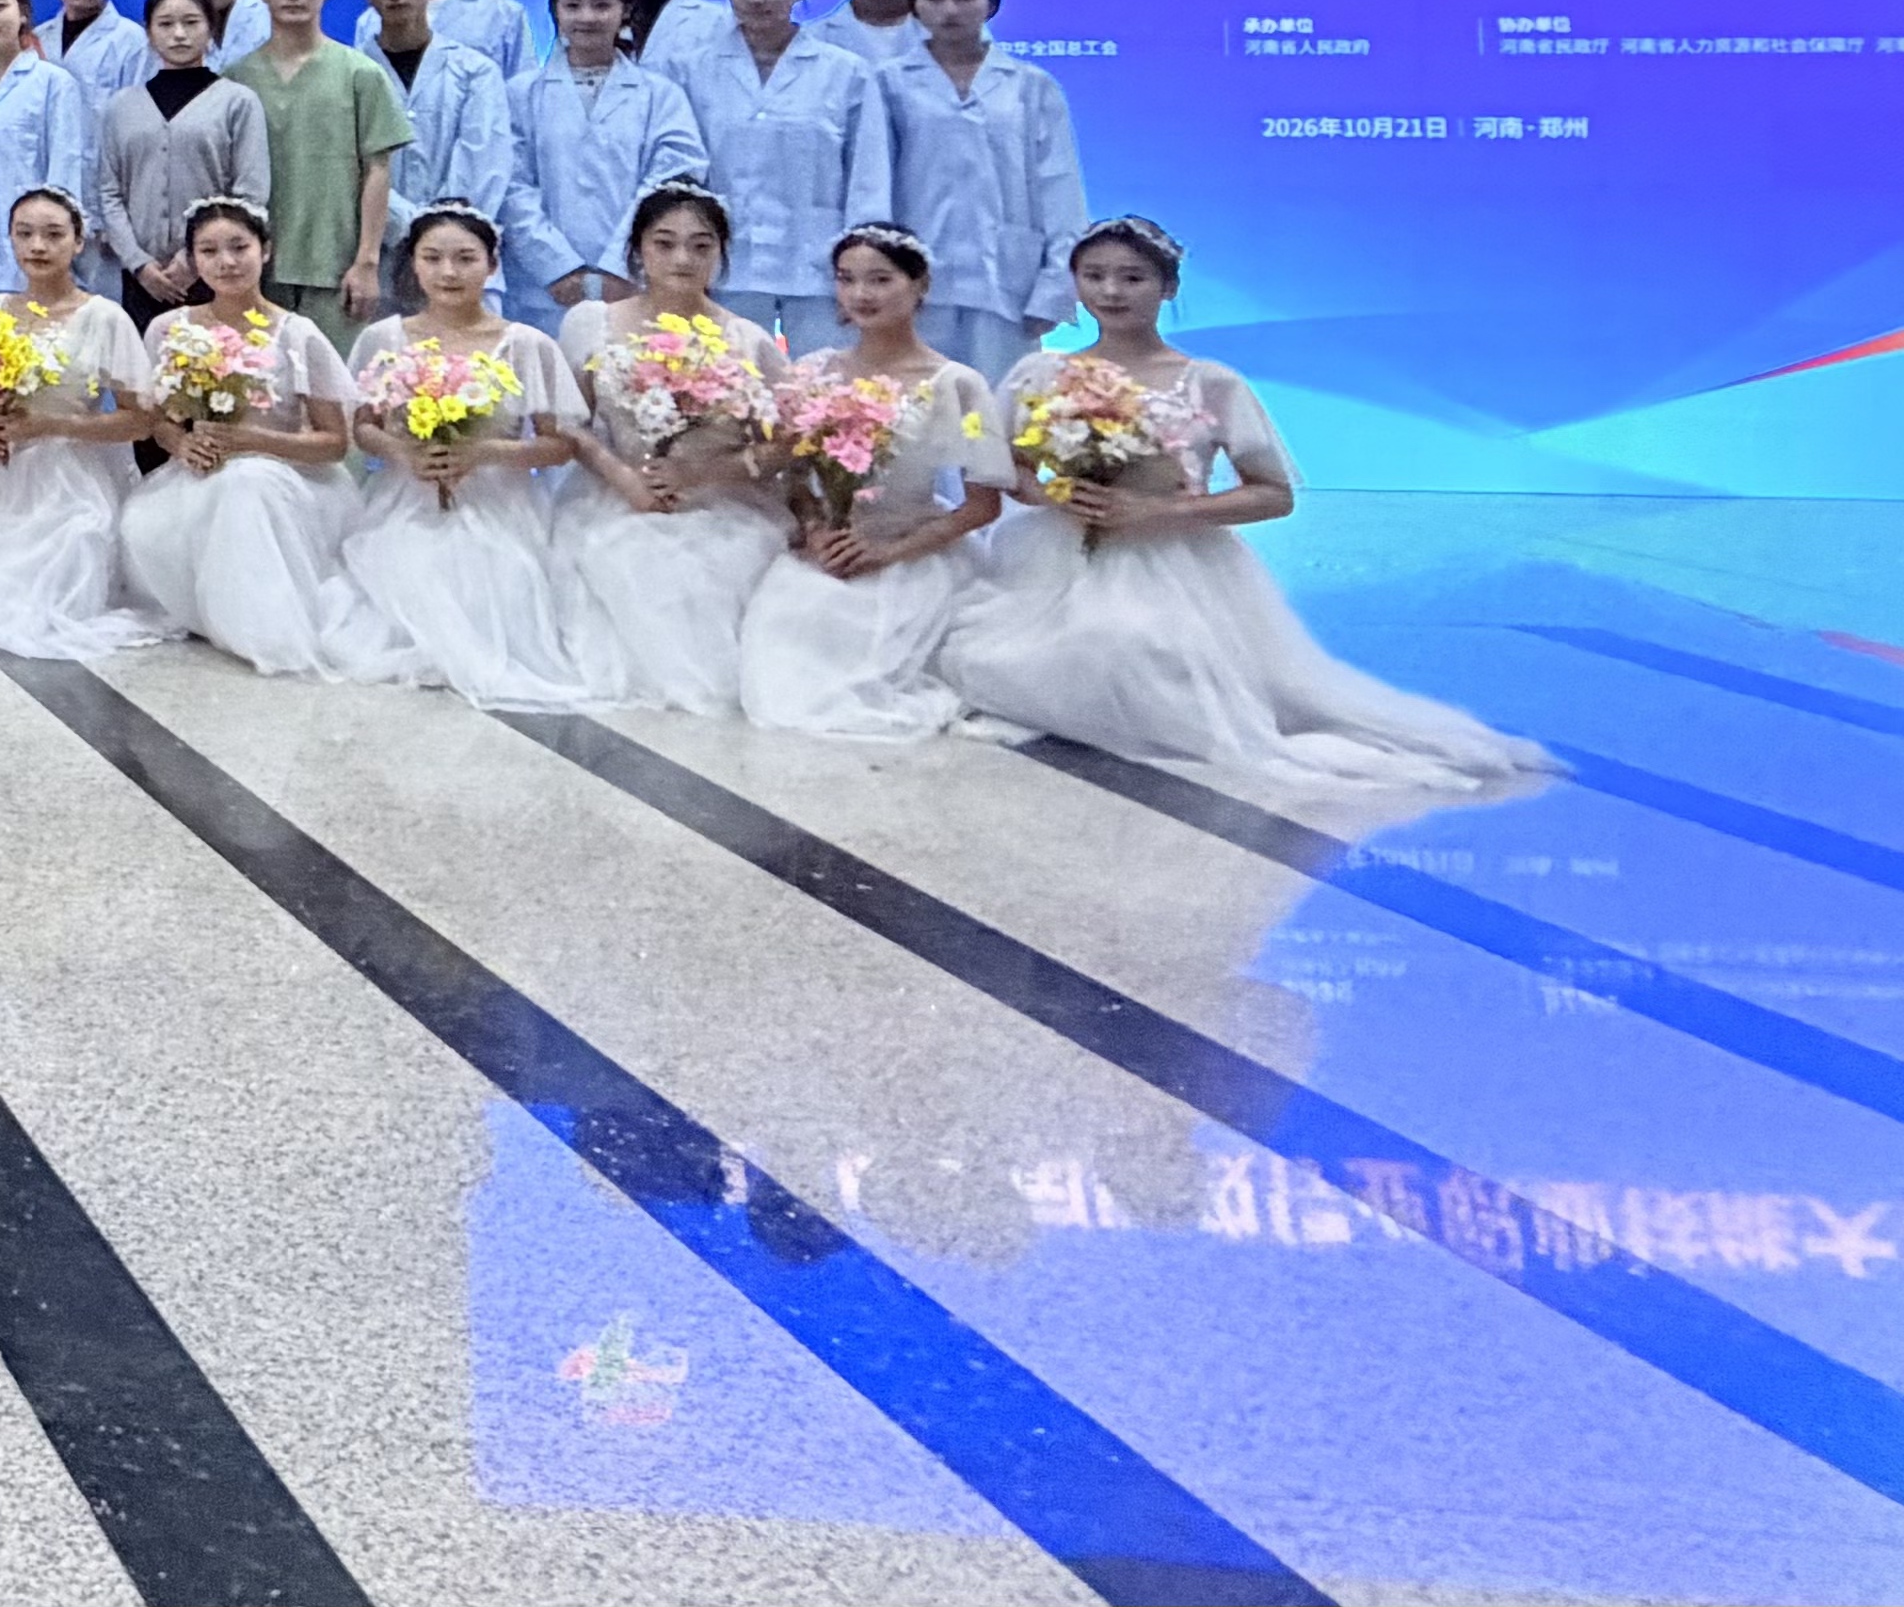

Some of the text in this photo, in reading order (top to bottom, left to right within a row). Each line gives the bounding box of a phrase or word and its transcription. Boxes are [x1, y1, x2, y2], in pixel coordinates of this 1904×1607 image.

[1243, 17, 1314, 34] 承办单位
[1498, 17, 1572, 33] 协办单位
[1245, 39, 1371, 56] 河南省人民政府
[1261, 116, 1589, 139] 2026年10月21日 河南·郑州
